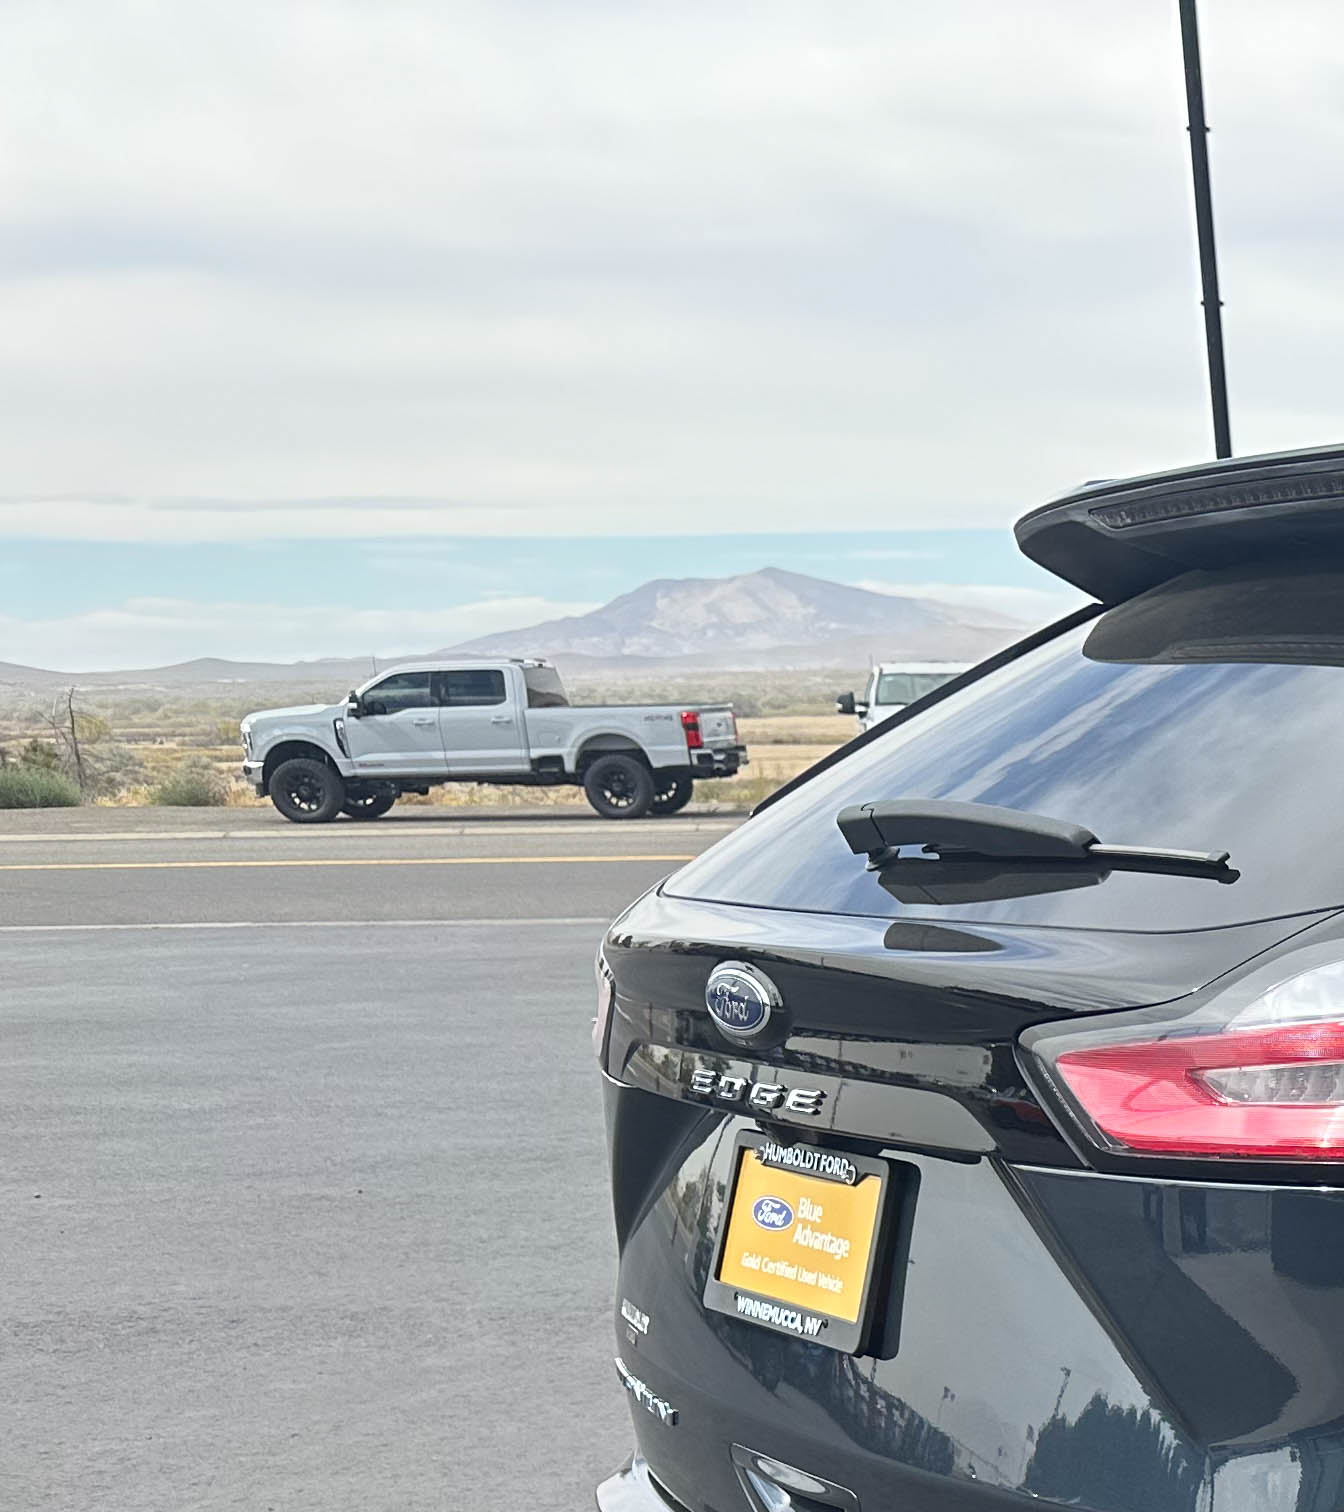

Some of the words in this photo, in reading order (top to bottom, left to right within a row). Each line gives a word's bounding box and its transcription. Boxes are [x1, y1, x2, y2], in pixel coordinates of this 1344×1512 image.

[714, 982, 750, 1022] Ford
[690, 1068, 828, 1116] EDGE
[764, 1142, 820, 1170] HUMBOLDT
[820, 1155, 849, 1179] FORD
[757, 1199, 787, 1227] Ford
[797, 1196, 823, 1223] Blue
[792, 1223, 851, 1260] Advantage
[740, 1251, 761, 1271] Gold
[761, 1256, 798, 1281] Certified
[797, 1265, 818, 1287] Used
[817, 1270, 844, 1294] Vehicle
[736, 1294, 804, 1335] WINNEMUCCA,
[803, 1315, 823, 1337] NV
